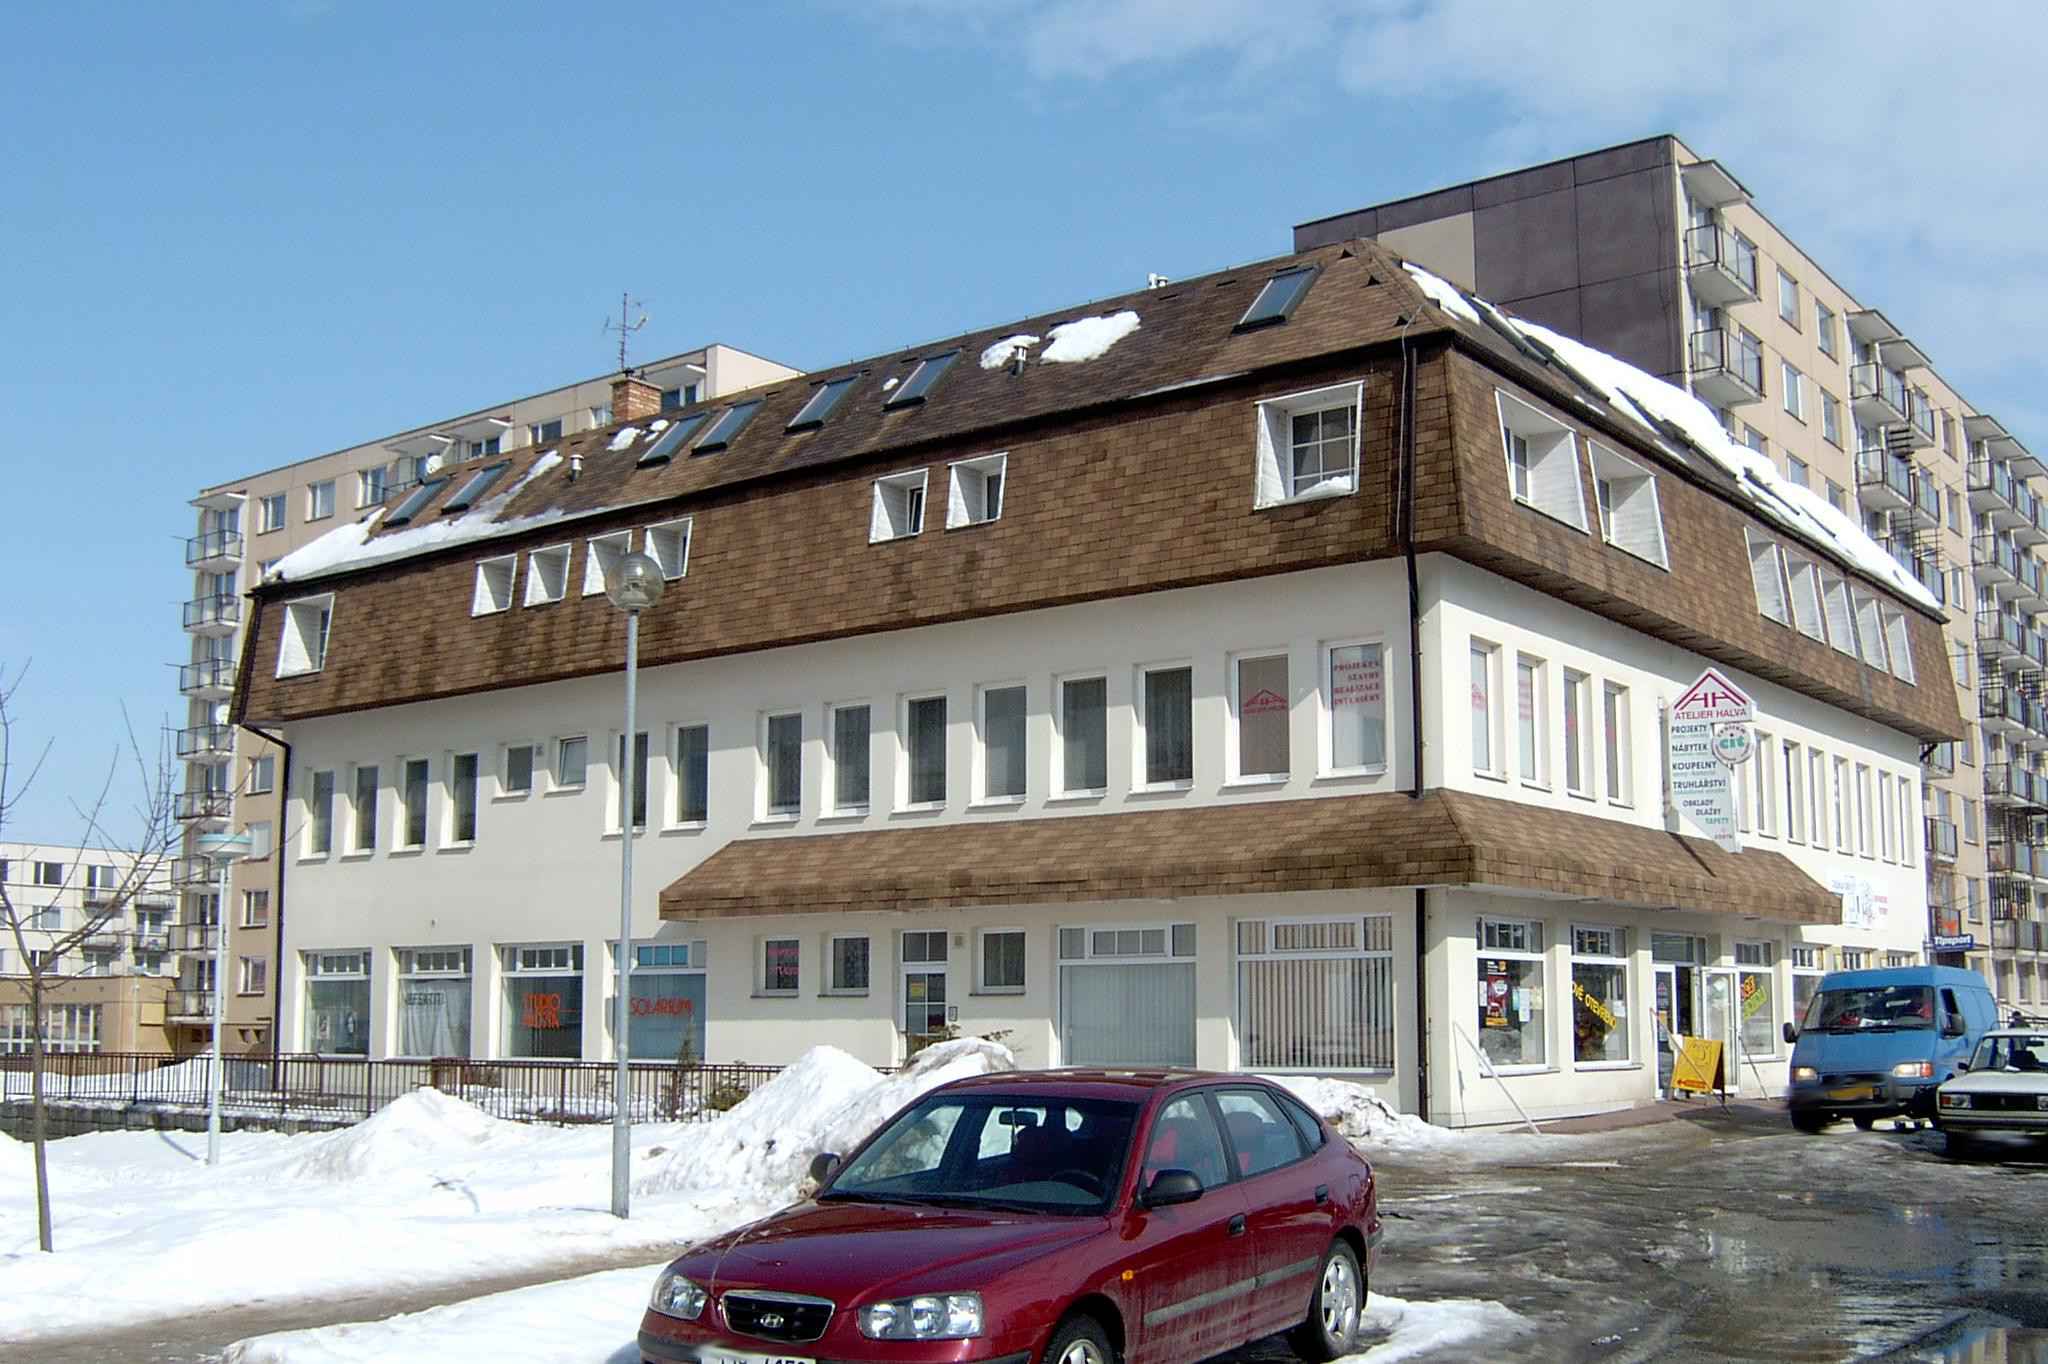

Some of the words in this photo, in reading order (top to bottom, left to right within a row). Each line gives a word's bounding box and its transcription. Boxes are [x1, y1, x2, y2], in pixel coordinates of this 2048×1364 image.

[1675, 711, 1713, 720] ATELIER
[1716, 708, 1747, 718] HALVA
[1671, 725, 1707, 733] PROJEKTY
[1672, 761, 1717, 770] KOUPELNY
[1683, 799, 1714, 807] OBKLADY
[1934, 935, 1972, 945] Tipsport
